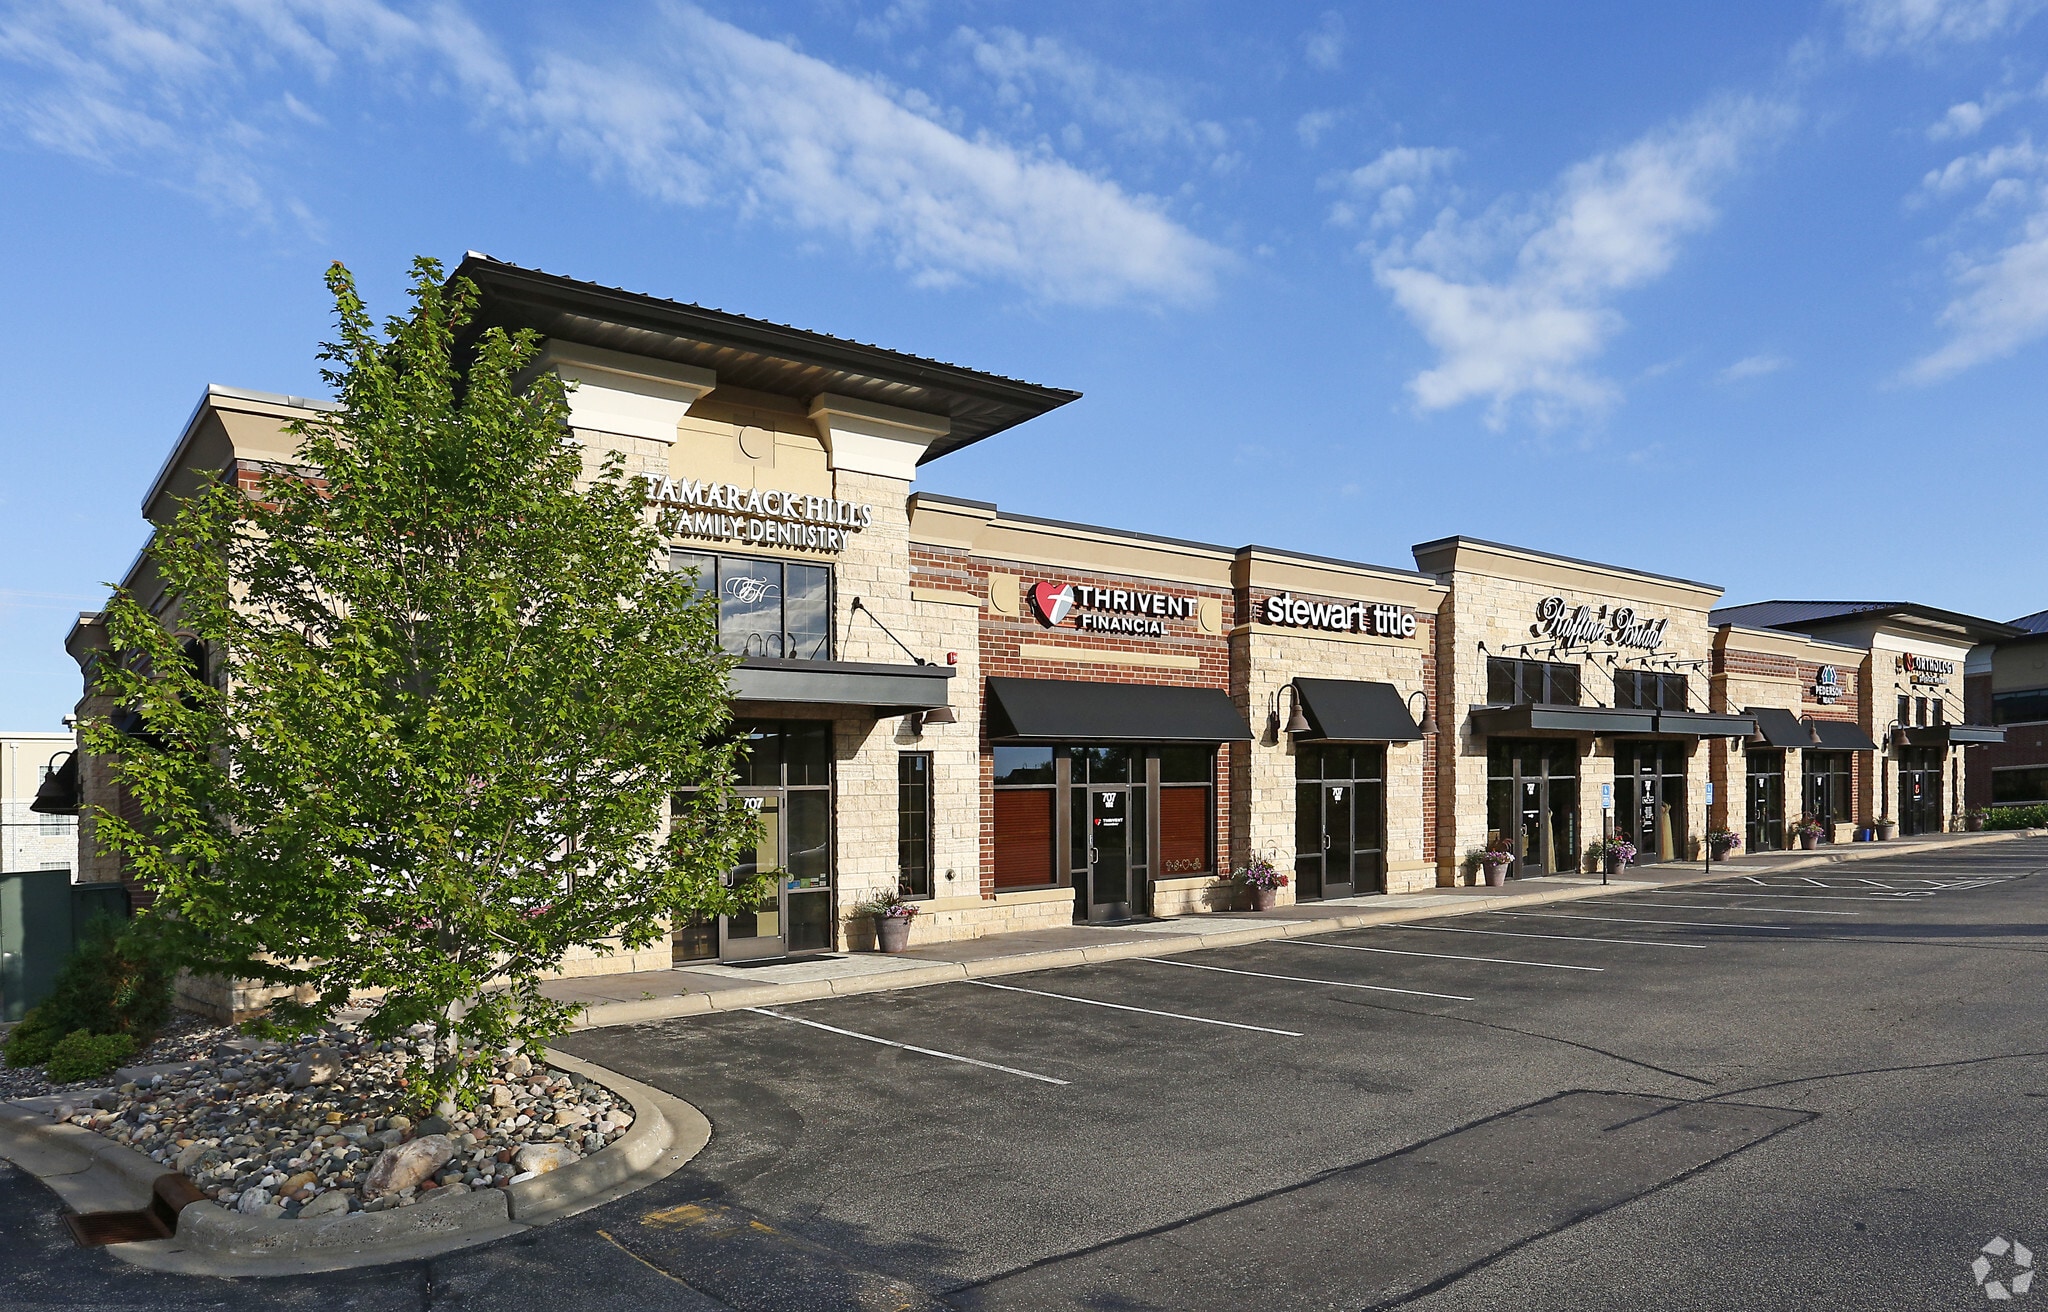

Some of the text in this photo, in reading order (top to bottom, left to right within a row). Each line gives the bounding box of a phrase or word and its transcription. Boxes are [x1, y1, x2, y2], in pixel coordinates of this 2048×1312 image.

[641, 472, 872, 528] TAMARACK HILLS
[749, 518, 850, 550] DENTISTRY
[1077, 585, 1198, 617] THRIVENT
[1082, 614, 1169, 635] FINANCIAL
[1267, 592, 1417, 637] stewart title
[1610, 606, 1669, 648] Bridal
[1915, 656, 1955, 674] ORTHOLOGY
[1815, 685, 1843, 696] PEDERSON
[743, 798, 764, 810] 707
[1102, 792, 1117, 802] 707
